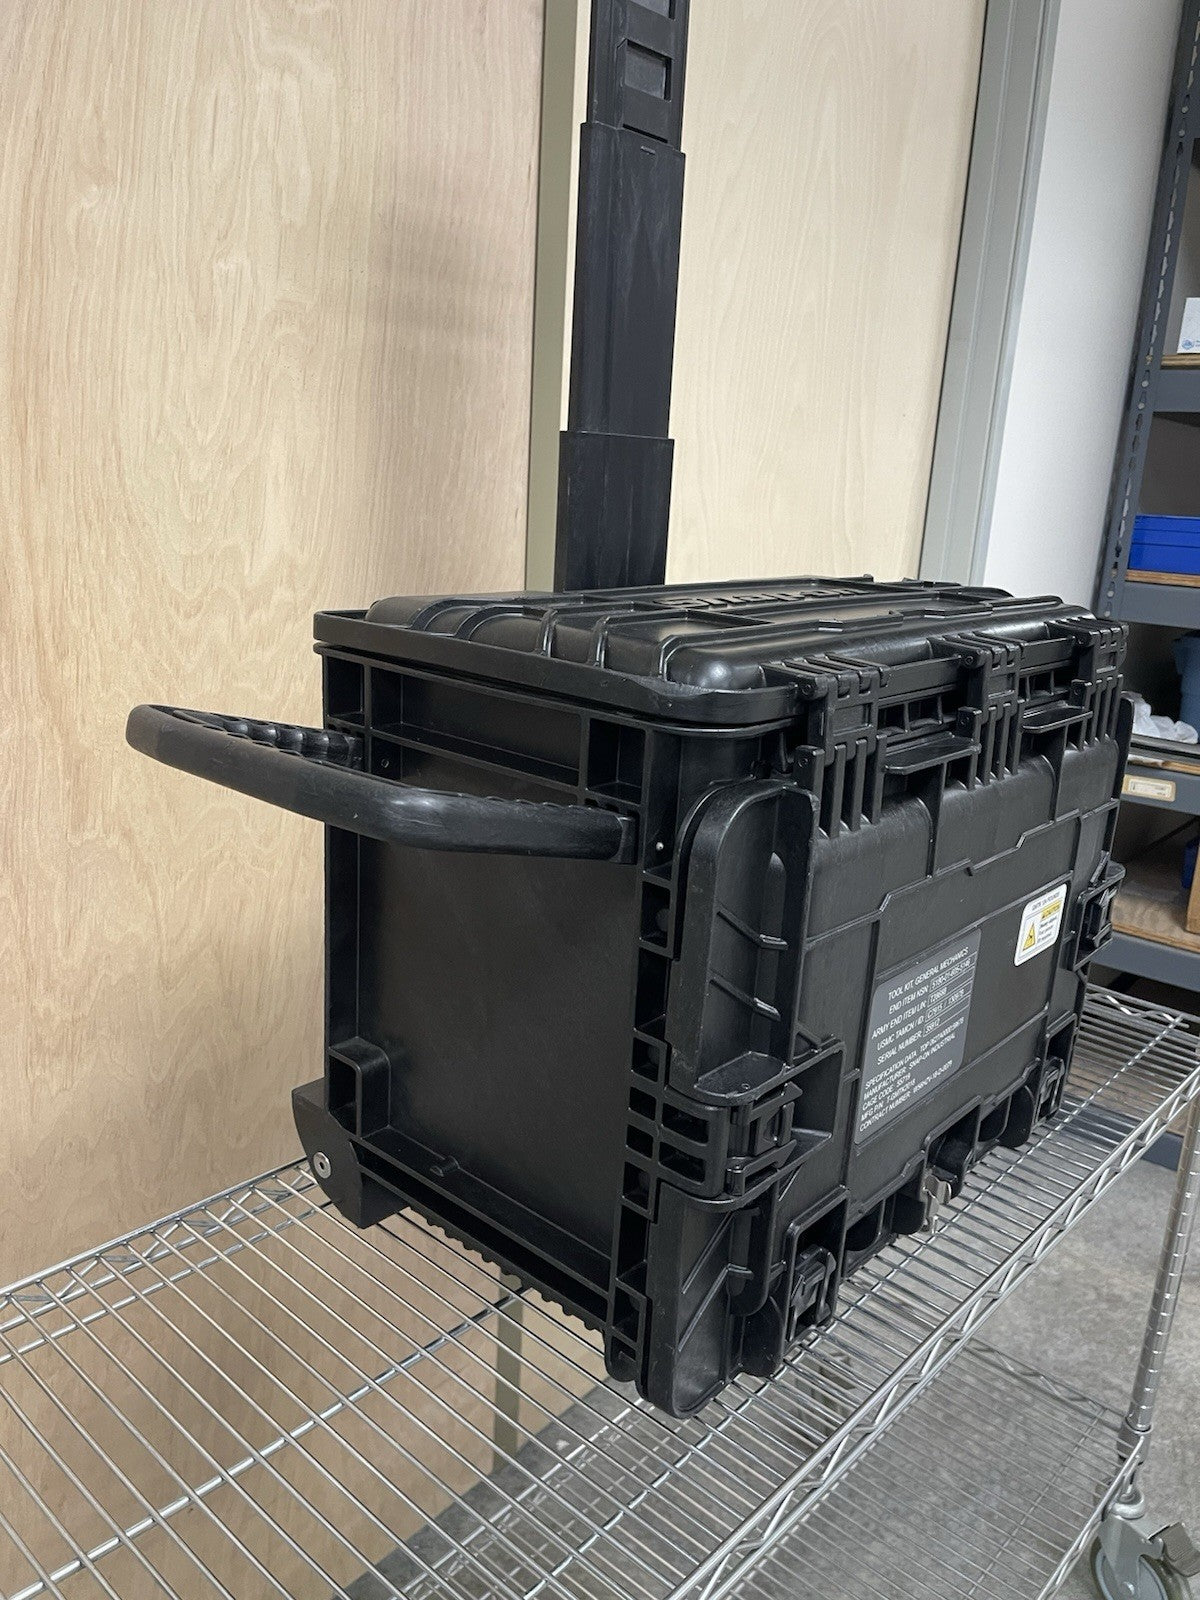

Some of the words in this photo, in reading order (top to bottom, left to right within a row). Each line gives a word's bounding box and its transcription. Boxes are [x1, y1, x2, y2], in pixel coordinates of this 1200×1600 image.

[887, 984, 904, 1002] TOOL
[913, 963, 940, 986] GENERAL
[938, 945, 969, 972] MECHANICS
[901, 990, 916, 1007] ITEM
[871, 1021, 889, 1040] ARMY
[902, 1004, 917, 1021] ITEM
[876, 1032, 895, 1051] USMC
[876, 1044, 898, 1066] SERIAL
[864, 1056, 904, 1090] SPECIFICATION
[861, 1093, 878, 1112] CAGE
[859, 1104, 888, 1133] CONTRACT
